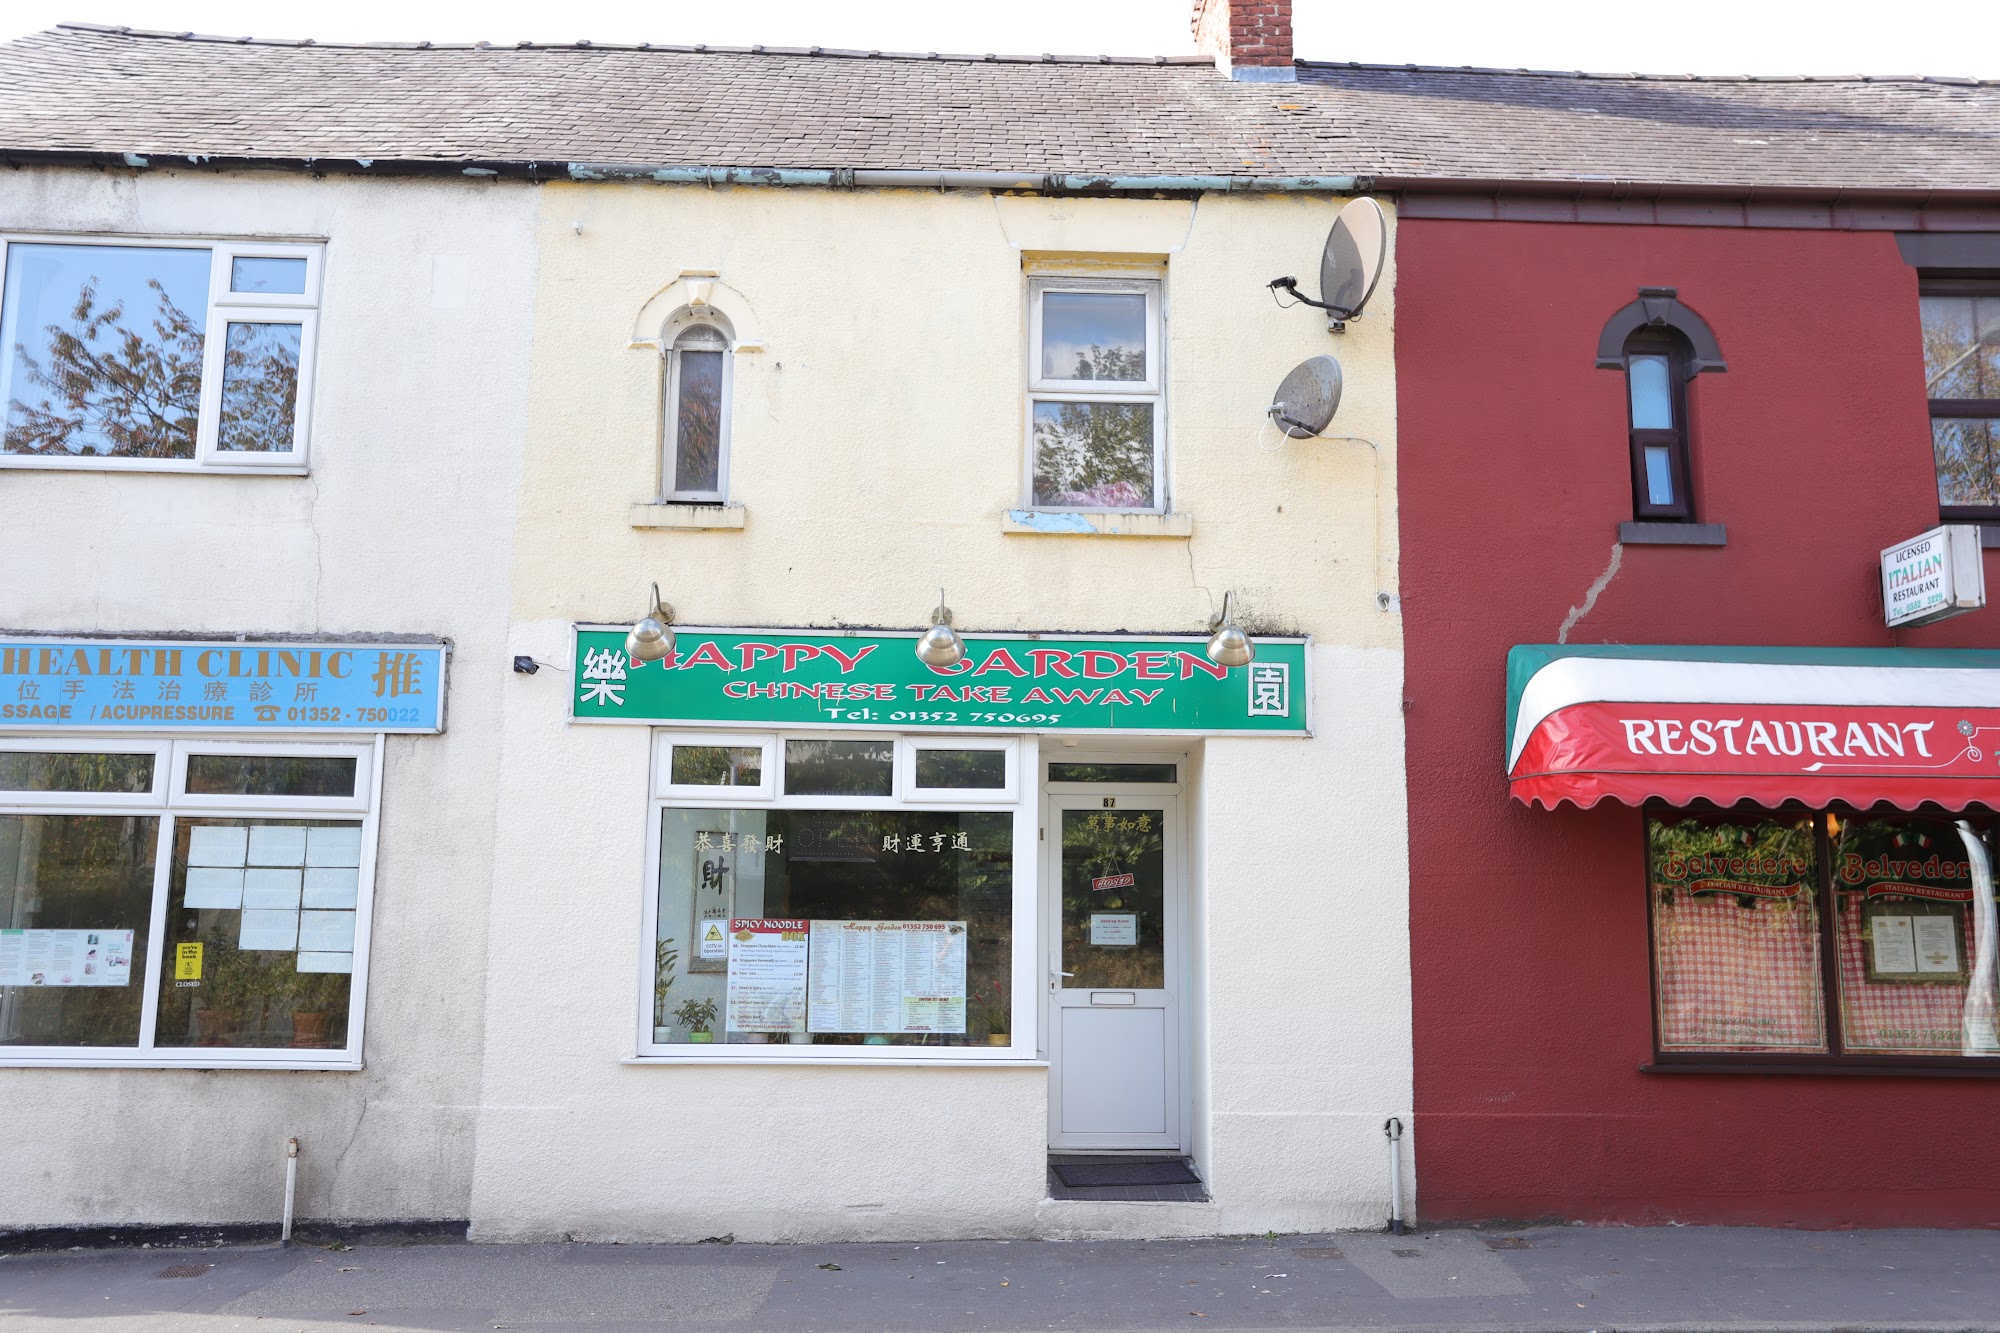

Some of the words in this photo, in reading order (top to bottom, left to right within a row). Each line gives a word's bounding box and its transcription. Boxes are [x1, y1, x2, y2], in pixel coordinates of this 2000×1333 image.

[1896, 541, 1931, 563] LICENSED
[1888, 553, 1943, 590] ITALIAN
[1892, 578, 1940, 603] RESTAURANT
[0, 647, 184, 677] HEALTH
[197, 649, 353, 679] CLINIC
[371, 651, 423, 698] 推
[579, 646, 628, 707] 樂
[723, 680, 897, 702] CHINESE
[905, 683, 1013, 704] TAKE
[1020, 687, 1164, 706] AWAY
[1247, 662, 1290, 718] 園
[0, 704, 72, 719] SSAGE
[823, 707, 879, 720] Tel:
[889, 711, 959, 722] 01352
[969, 711, 1062, 724] 750695
[1619, 717, 1935, 758] RESTAURANT
[1103, 797, 1115, 808] 87
[1086, 813, 1152, 833] 萬事如意
[693, 831, 784, 855] 恭喜發財
[881, 831, 973, 854] 財運亨通
[1662, 850, 1808, 881] Belvedere
[1840, 853, 1971, 884] Belveder
[1096, 877, 1131, 889] CLOSED
[1707, 881, 1737, 890] ITALIAN
[1738, 885, 1787, 896] RESTAURANT
[1885, 884, 1915, 893] ITALIAN
[1916, 888, 1966, 899] RESTAURANT
[734, 919, 762, 929] SPICY
[763, 920, 804, 929] NOODLE
[843, 922, 872, 931] Happy
[1880, 1029, 1918, 1039] 01352
